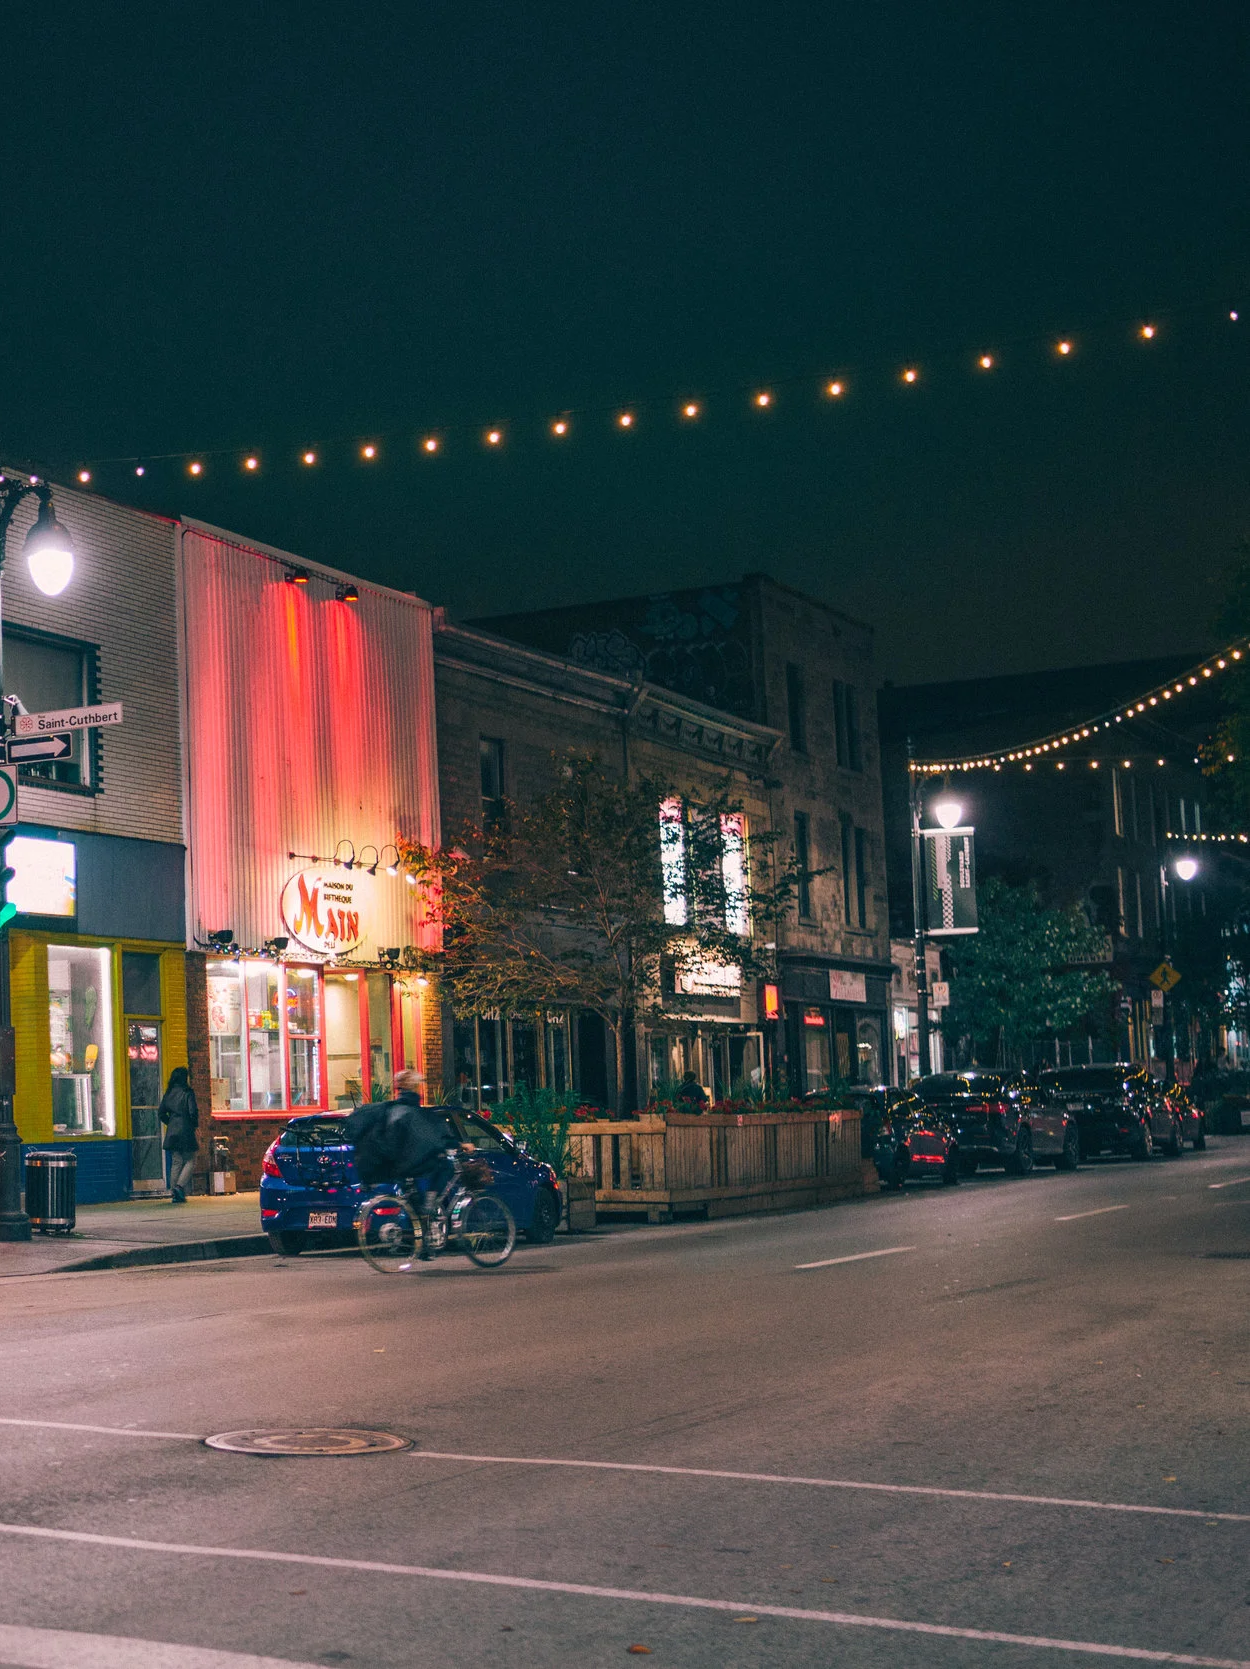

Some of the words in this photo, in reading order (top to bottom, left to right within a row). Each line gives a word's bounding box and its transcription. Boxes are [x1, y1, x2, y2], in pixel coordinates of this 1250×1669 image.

[37, 711, 118, 730] Saint-Cuthbert
[323, 882, 344, 890] MAISON
[345, 883, 353, 891] DU
